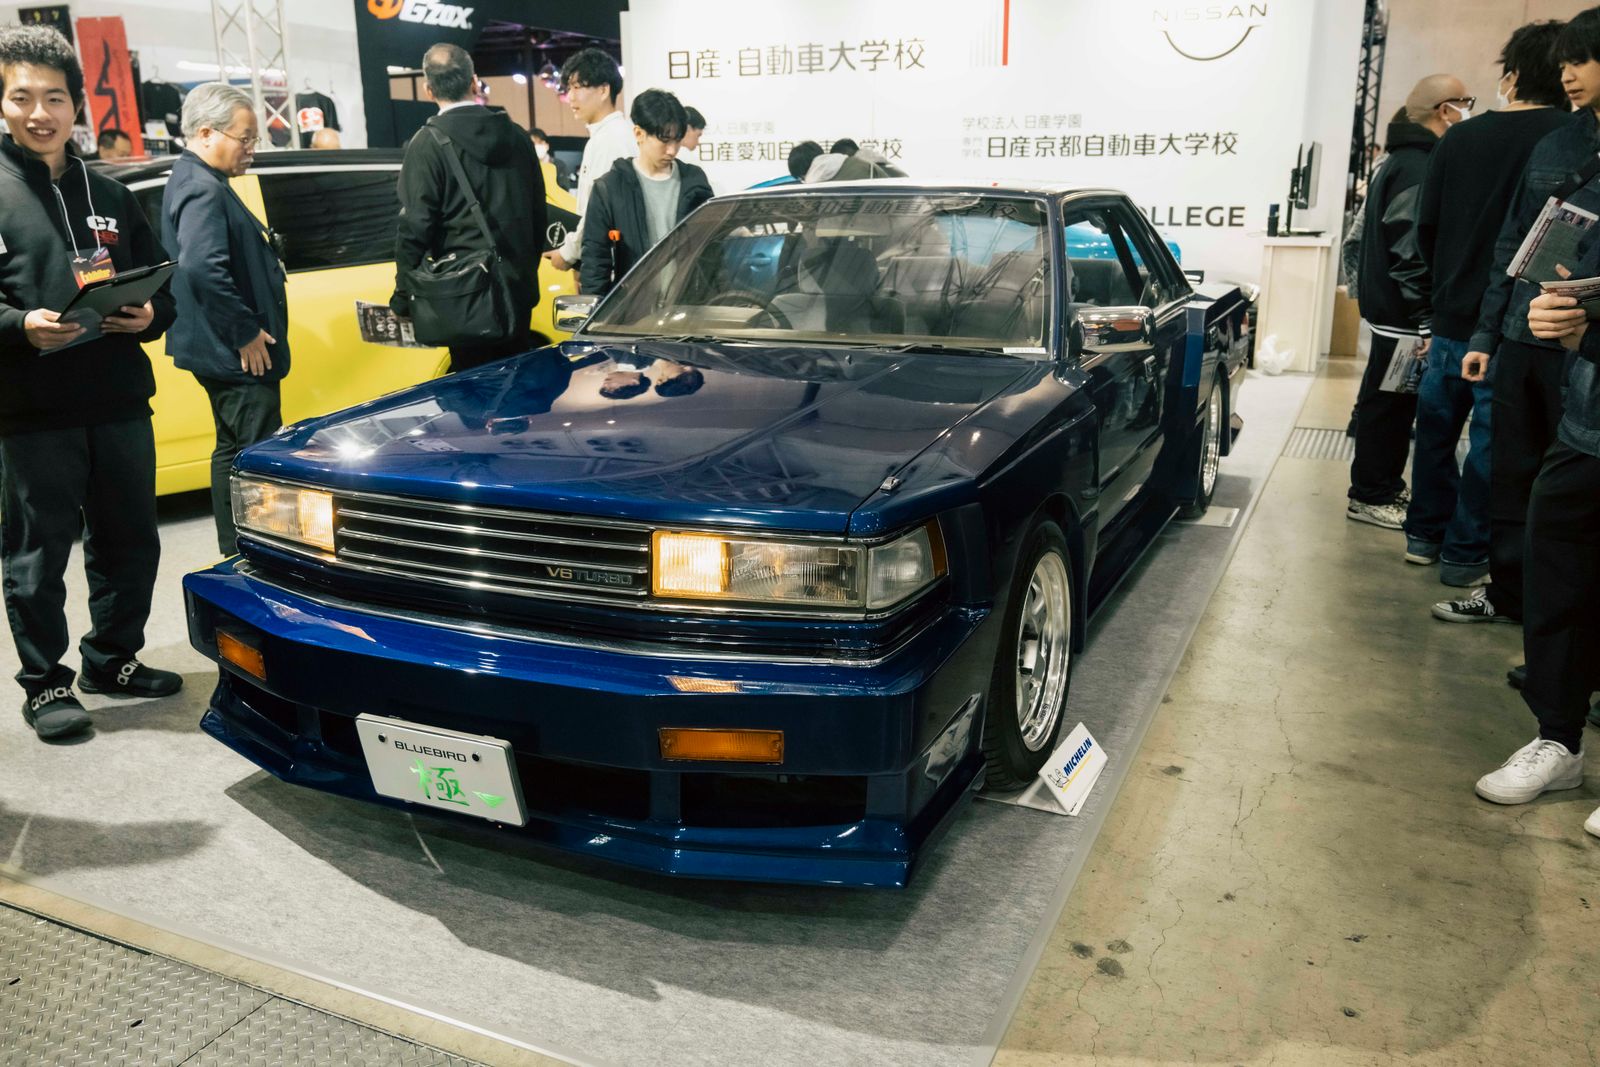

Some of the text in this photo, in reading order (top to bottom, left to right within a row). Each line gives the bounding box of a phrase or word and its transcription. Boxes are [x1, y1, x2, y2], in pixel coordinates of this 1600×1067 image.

[1152, 2, 1268, 22] NISSAN
[987, 132, 1240, 158] 日産京都自動車大学校
[1140, 206, 1245, 227] LLEGE
[394, 740, 467, 762] BLUEBIRD
[1063, 737, 1092, 776] MICHELIN
